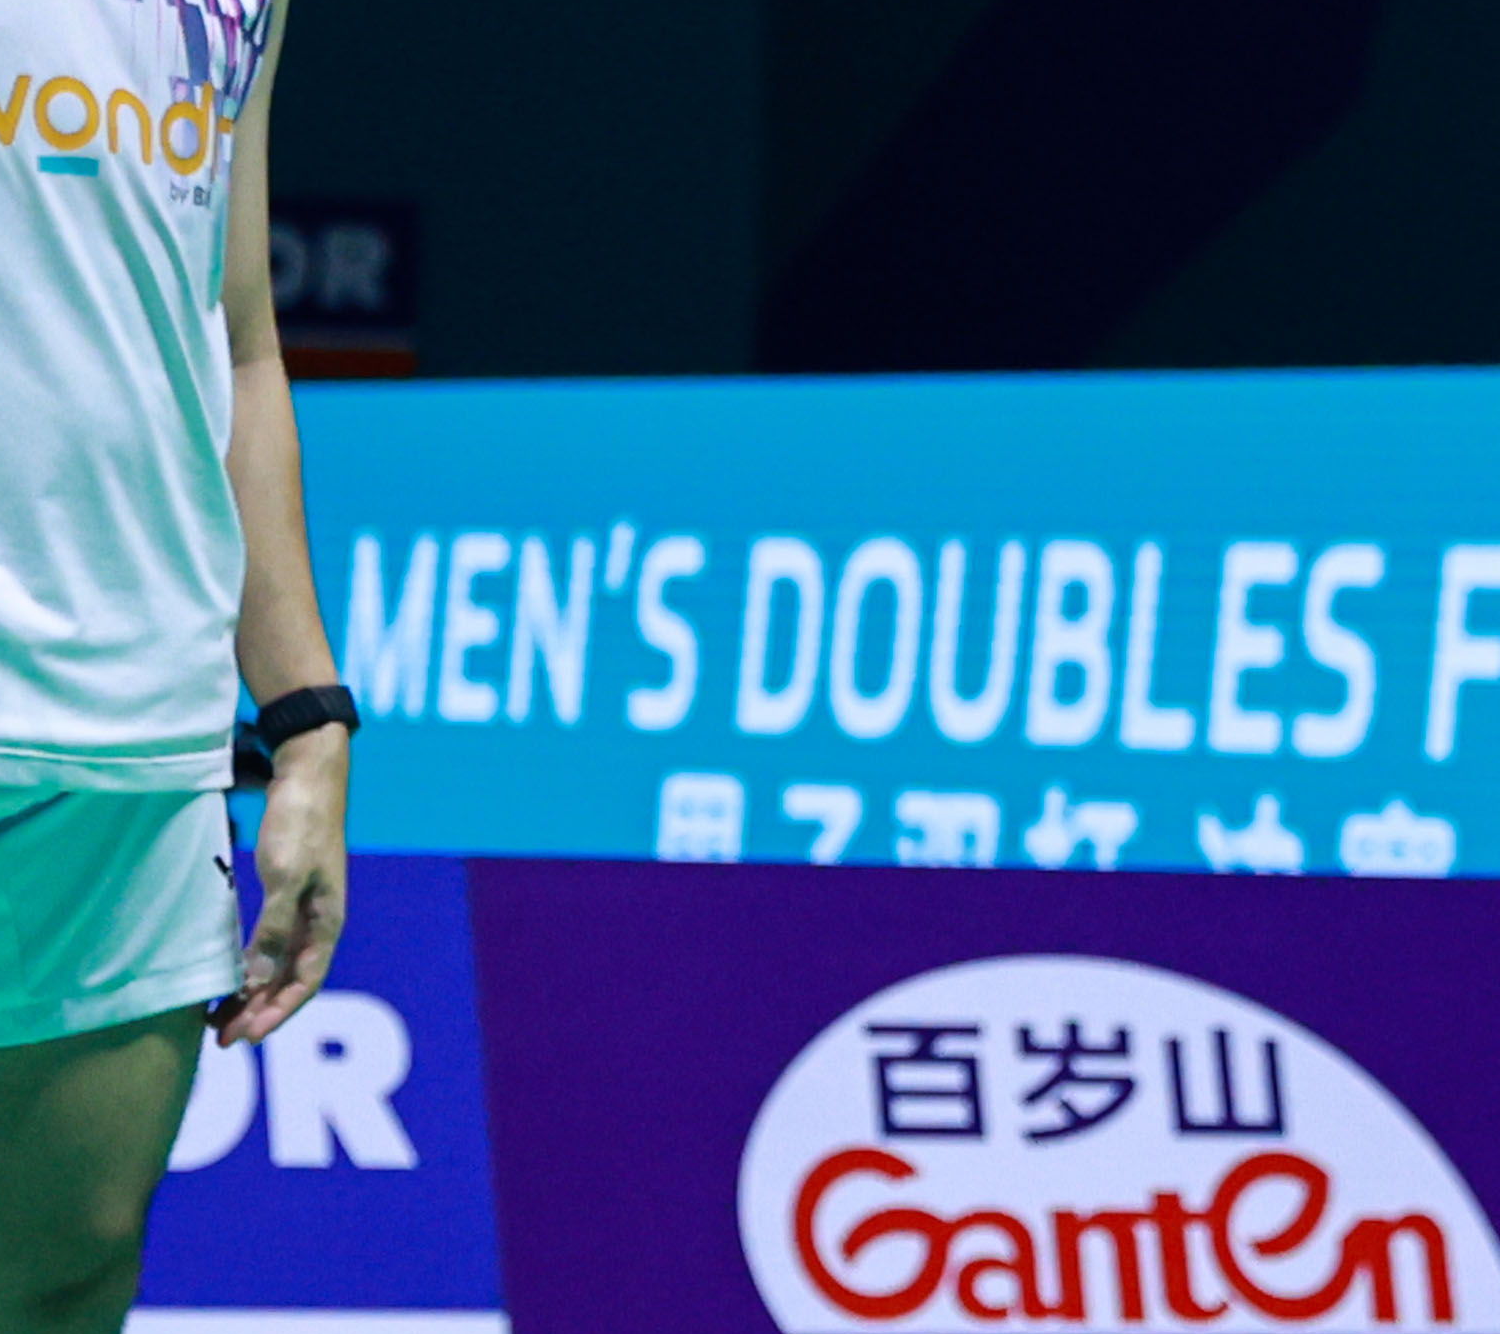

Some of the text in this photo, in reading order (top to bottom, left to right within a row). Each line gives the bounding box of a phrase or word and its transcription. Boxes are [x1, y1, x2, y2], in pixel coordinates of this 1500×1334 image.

[336, 520, 706, 733] MEN'S
[734, 534, 1386, 760] DOUBLES
[862, 1017, 1287, 1145] 百岁山
